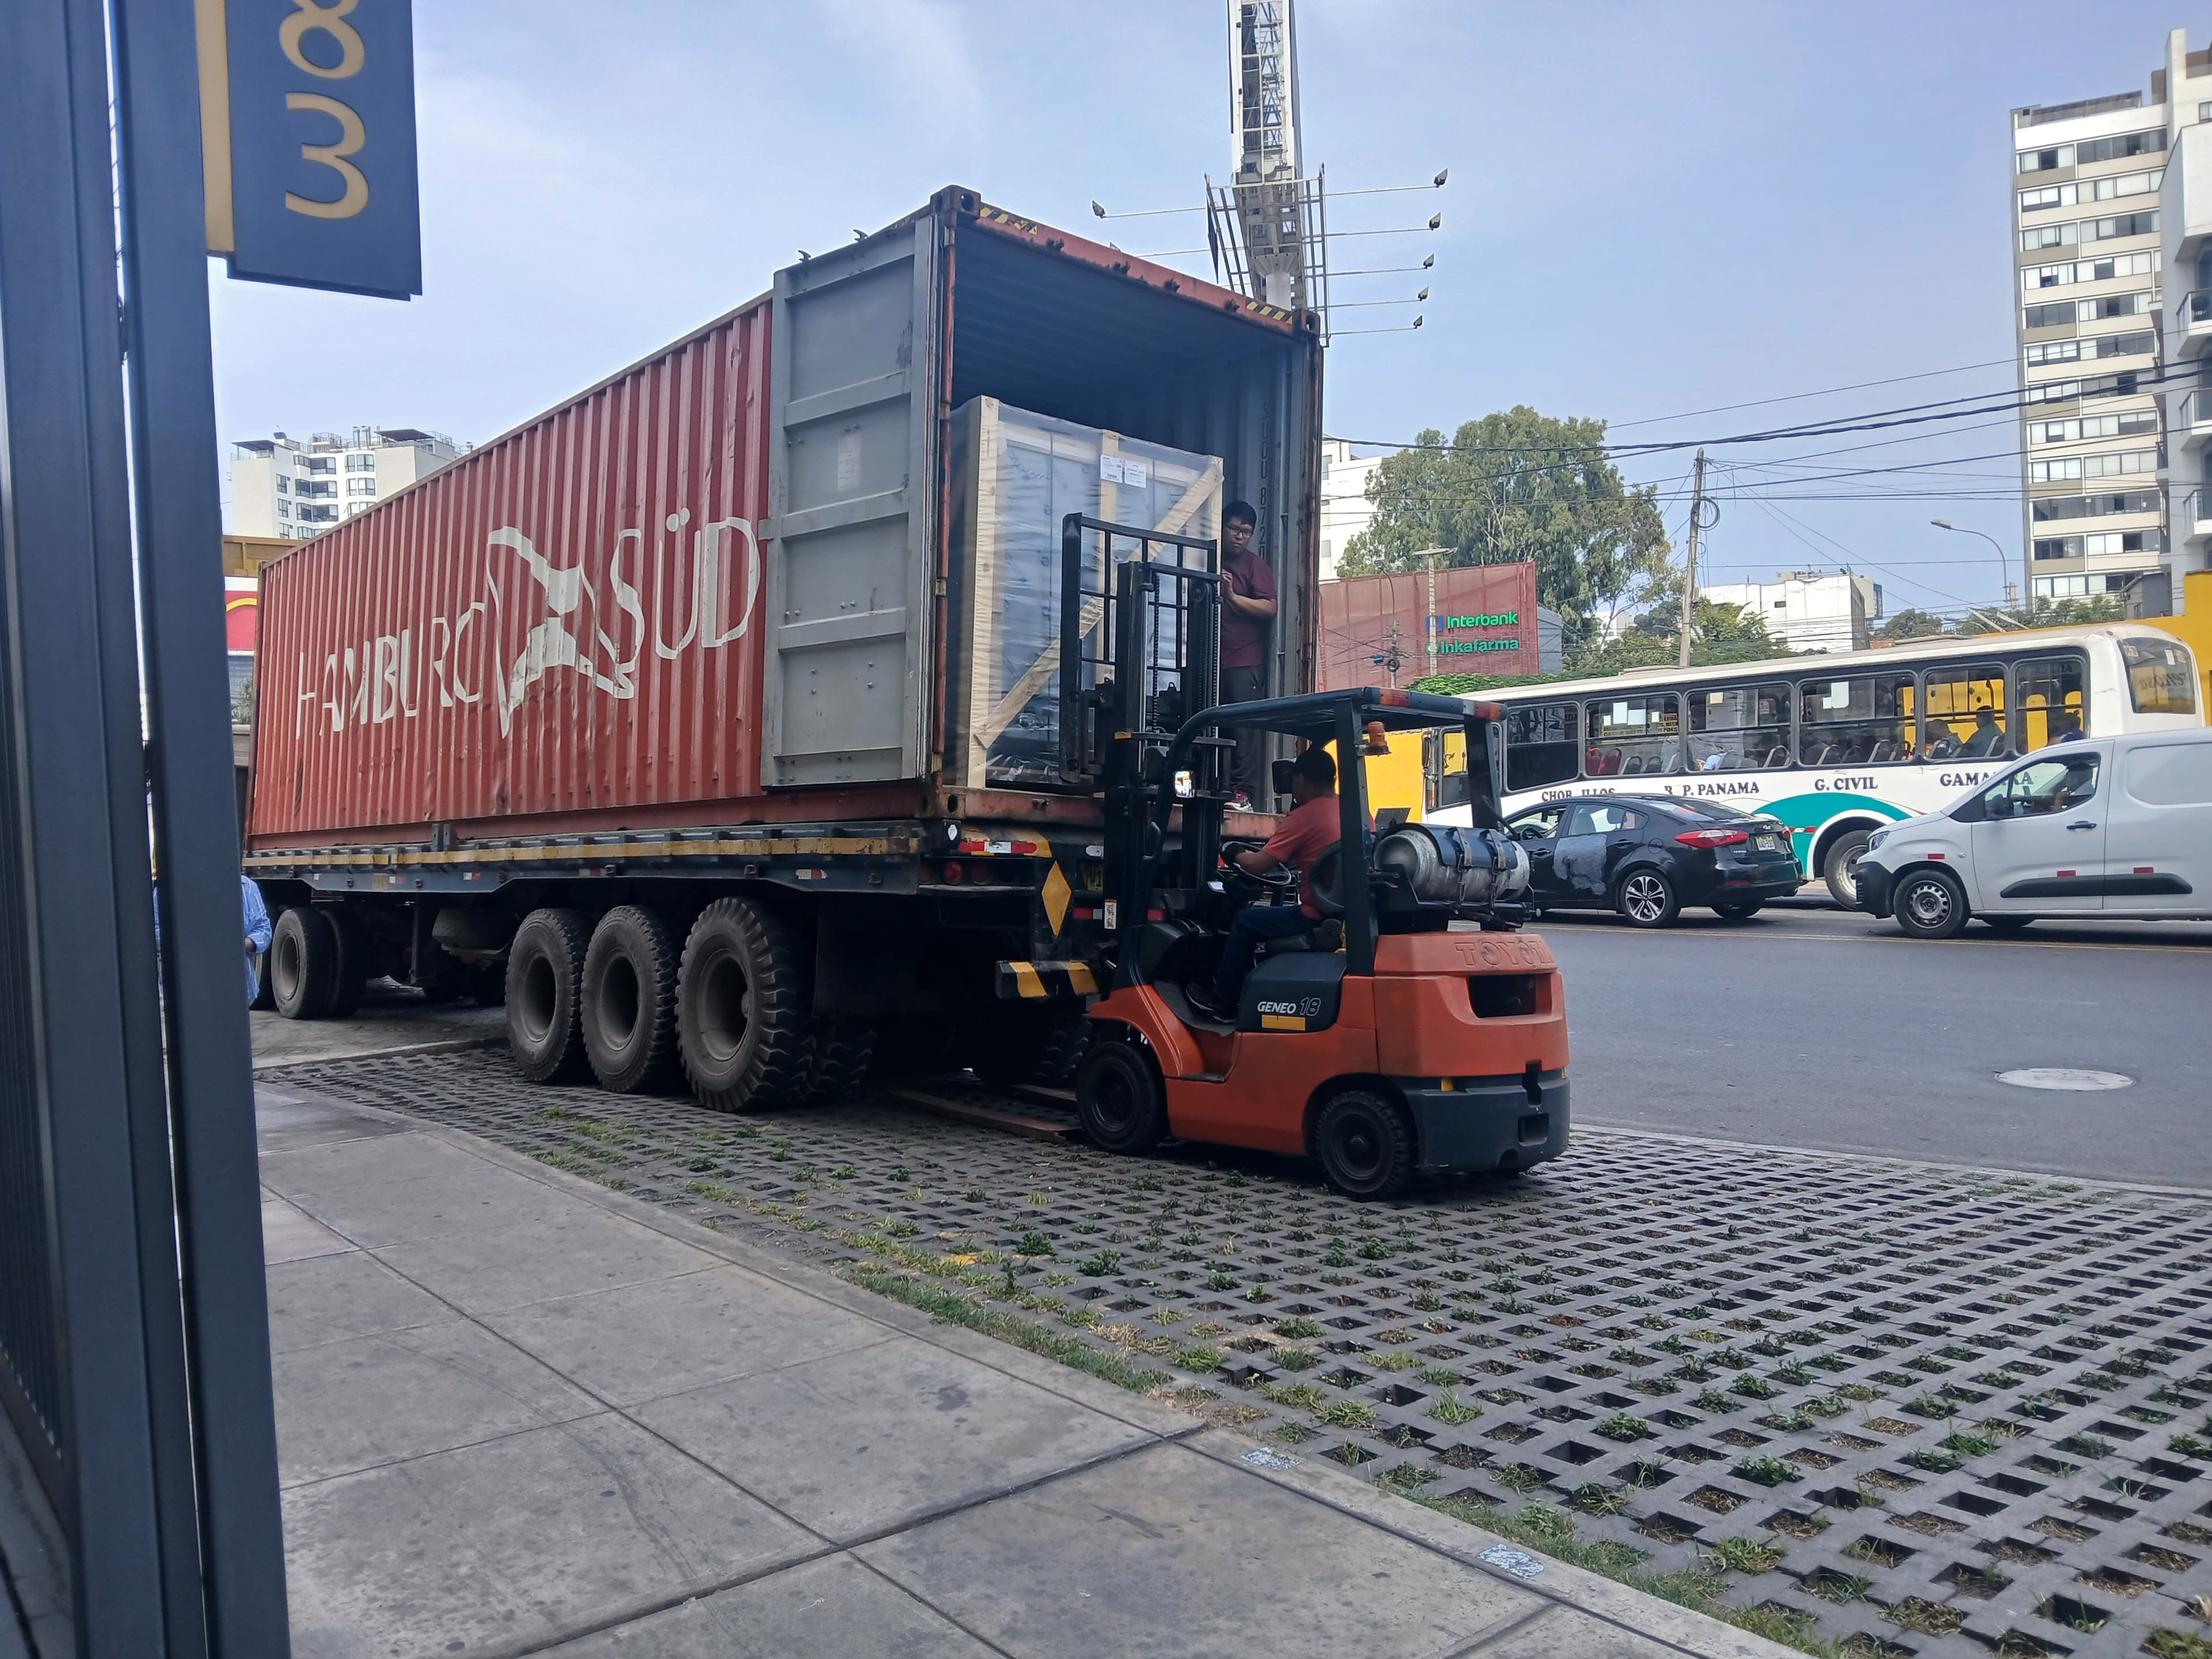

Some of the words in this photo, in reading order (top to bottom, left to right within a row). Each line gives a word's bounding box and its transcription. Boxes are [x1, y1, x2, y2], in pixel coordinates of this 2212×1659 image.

[610, 507, 760, 673] SÜD
[1447, 611, 1518, 629] Interbank
[1441, 639, 1519, 655] Inkafarma
[1698, 782, 1759, 795] PANAMA
[1815, 779, 1830, 791] G.
[1834, 777, 1878, 790] CIVIL
[1454, 941, 1555, 966] TOYOTA
[1257, 1001, 1297, 1014] GENEO
[1300, 997, 1321, 1016] 18
